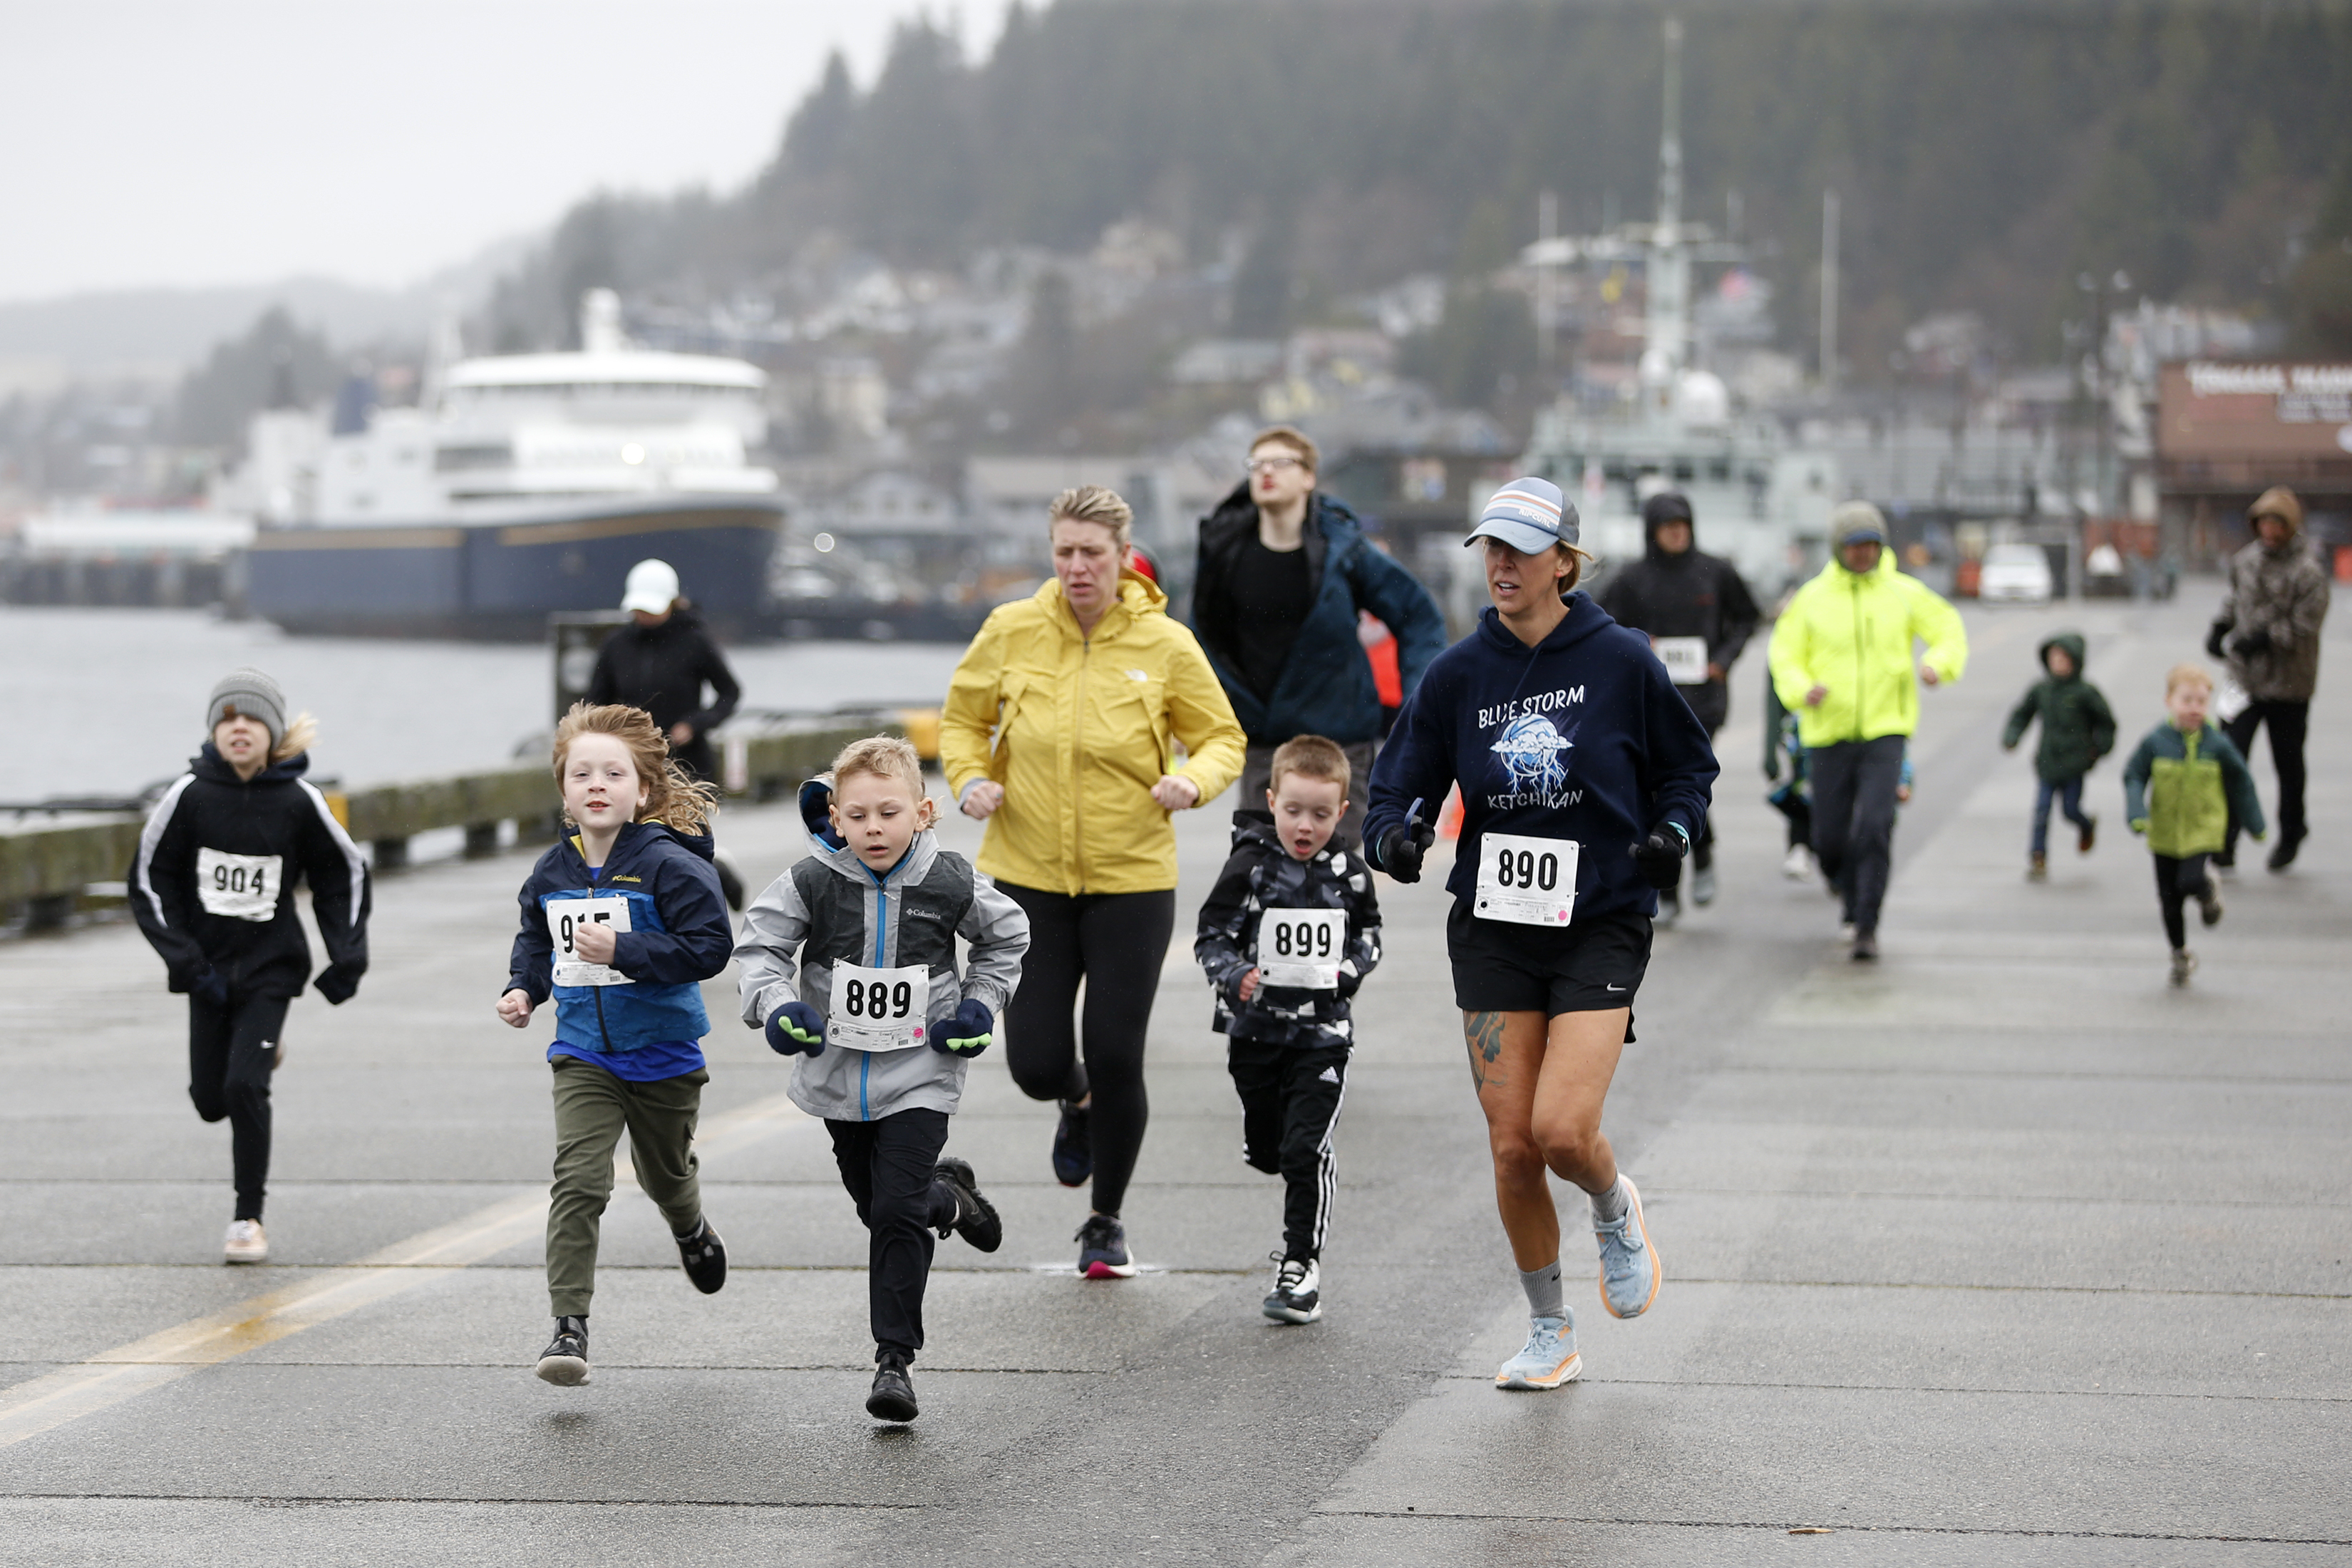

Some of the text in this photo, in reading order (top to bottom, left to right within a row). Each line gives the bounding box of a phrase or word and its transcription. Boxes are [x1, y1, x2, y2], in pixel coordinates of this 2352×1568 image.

[1477, 684, 1585, 730] BLUE STORM
[1487, 789, 1584, 810] KETCHIKAN
[215, 865, 264, 895] 904
[1497, 848, 1558, 891] 890
[913, 908, 941, 919] Columbia
[1276, 922, 1331, 957] 899
[846, 979, 912, 1020] 889
